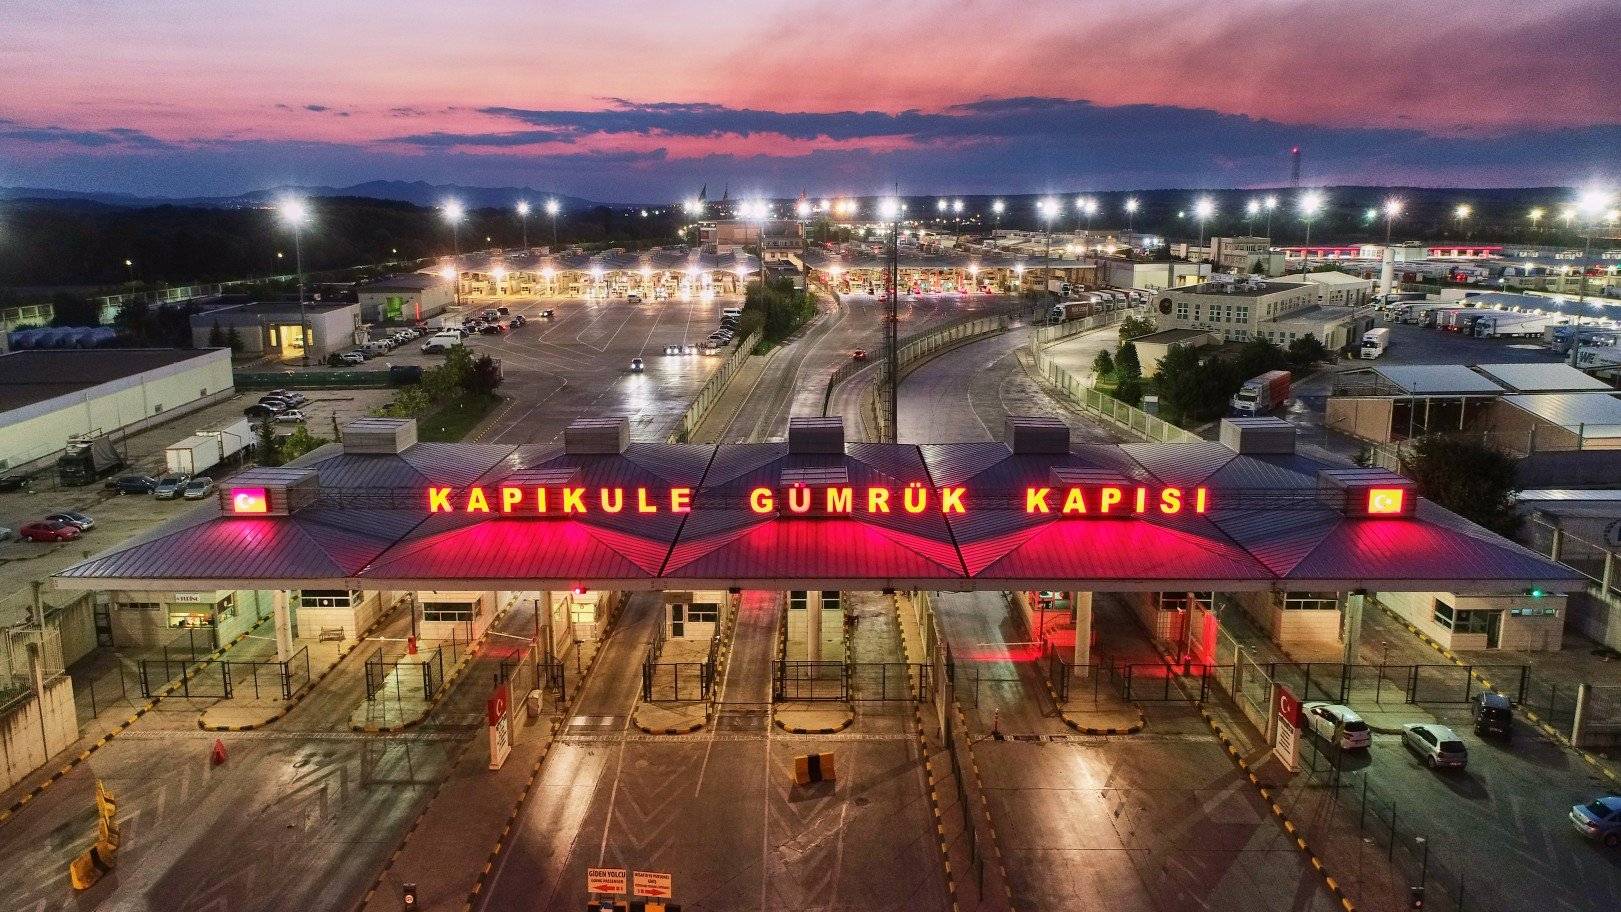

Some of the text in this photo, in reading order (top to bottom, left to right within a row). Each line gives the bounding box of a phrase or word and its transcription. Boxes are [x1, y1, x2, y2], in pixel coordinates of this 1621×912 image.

[429, 482, 1206, 513] KAPIKULE GÜMRÜK KAPISI
[607, 871, 626, 879] YOLCU
